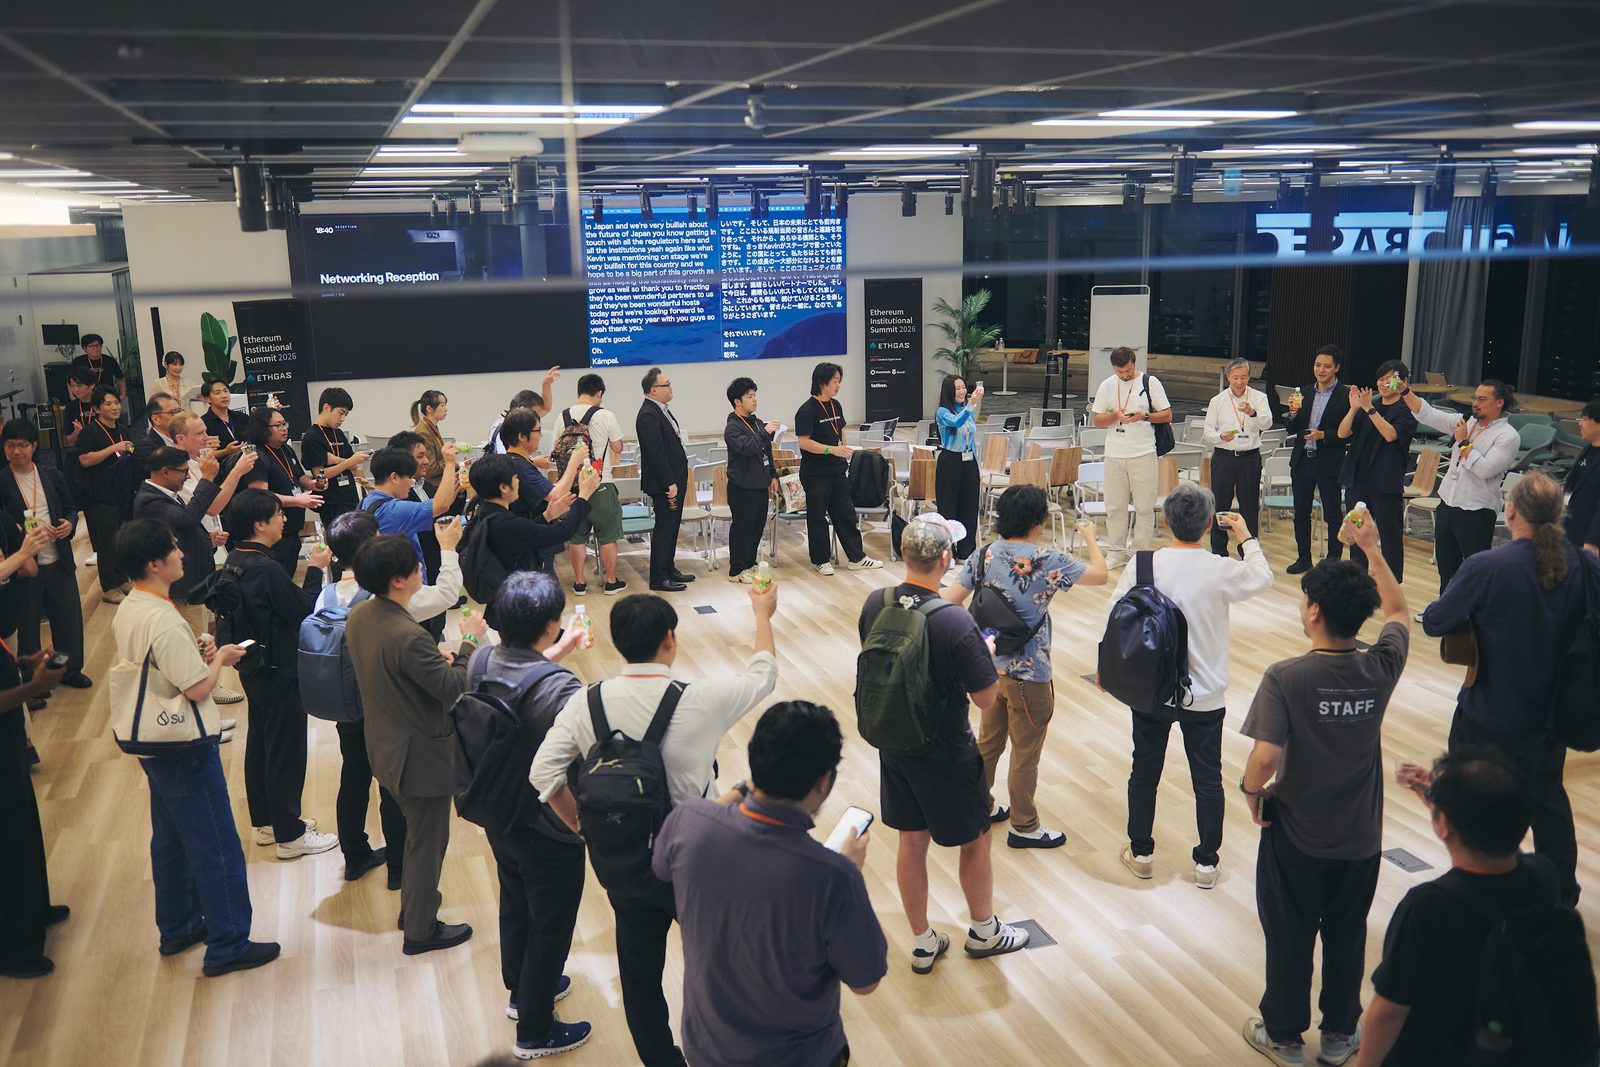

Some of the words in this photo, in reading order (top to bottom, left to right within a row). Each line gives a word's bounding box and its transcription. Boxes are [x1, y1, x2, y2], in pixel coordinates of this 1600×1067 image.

[320, 273, 384, 284] Networking
[386, 272, 439, 284] Reception
[590, 326, 607, 334] yeah
[243, 335, 282, 344] Ethereum
[244, 343, 293, 354] Institutional
[245, 354, 277, 364] Summit
[278, 353, 296, 361] 2026
[257, 372, 292, 382] ETHGAS
[1319, 699, 1374, 716] STAFF
[171, 712, 185, 724] Sui
